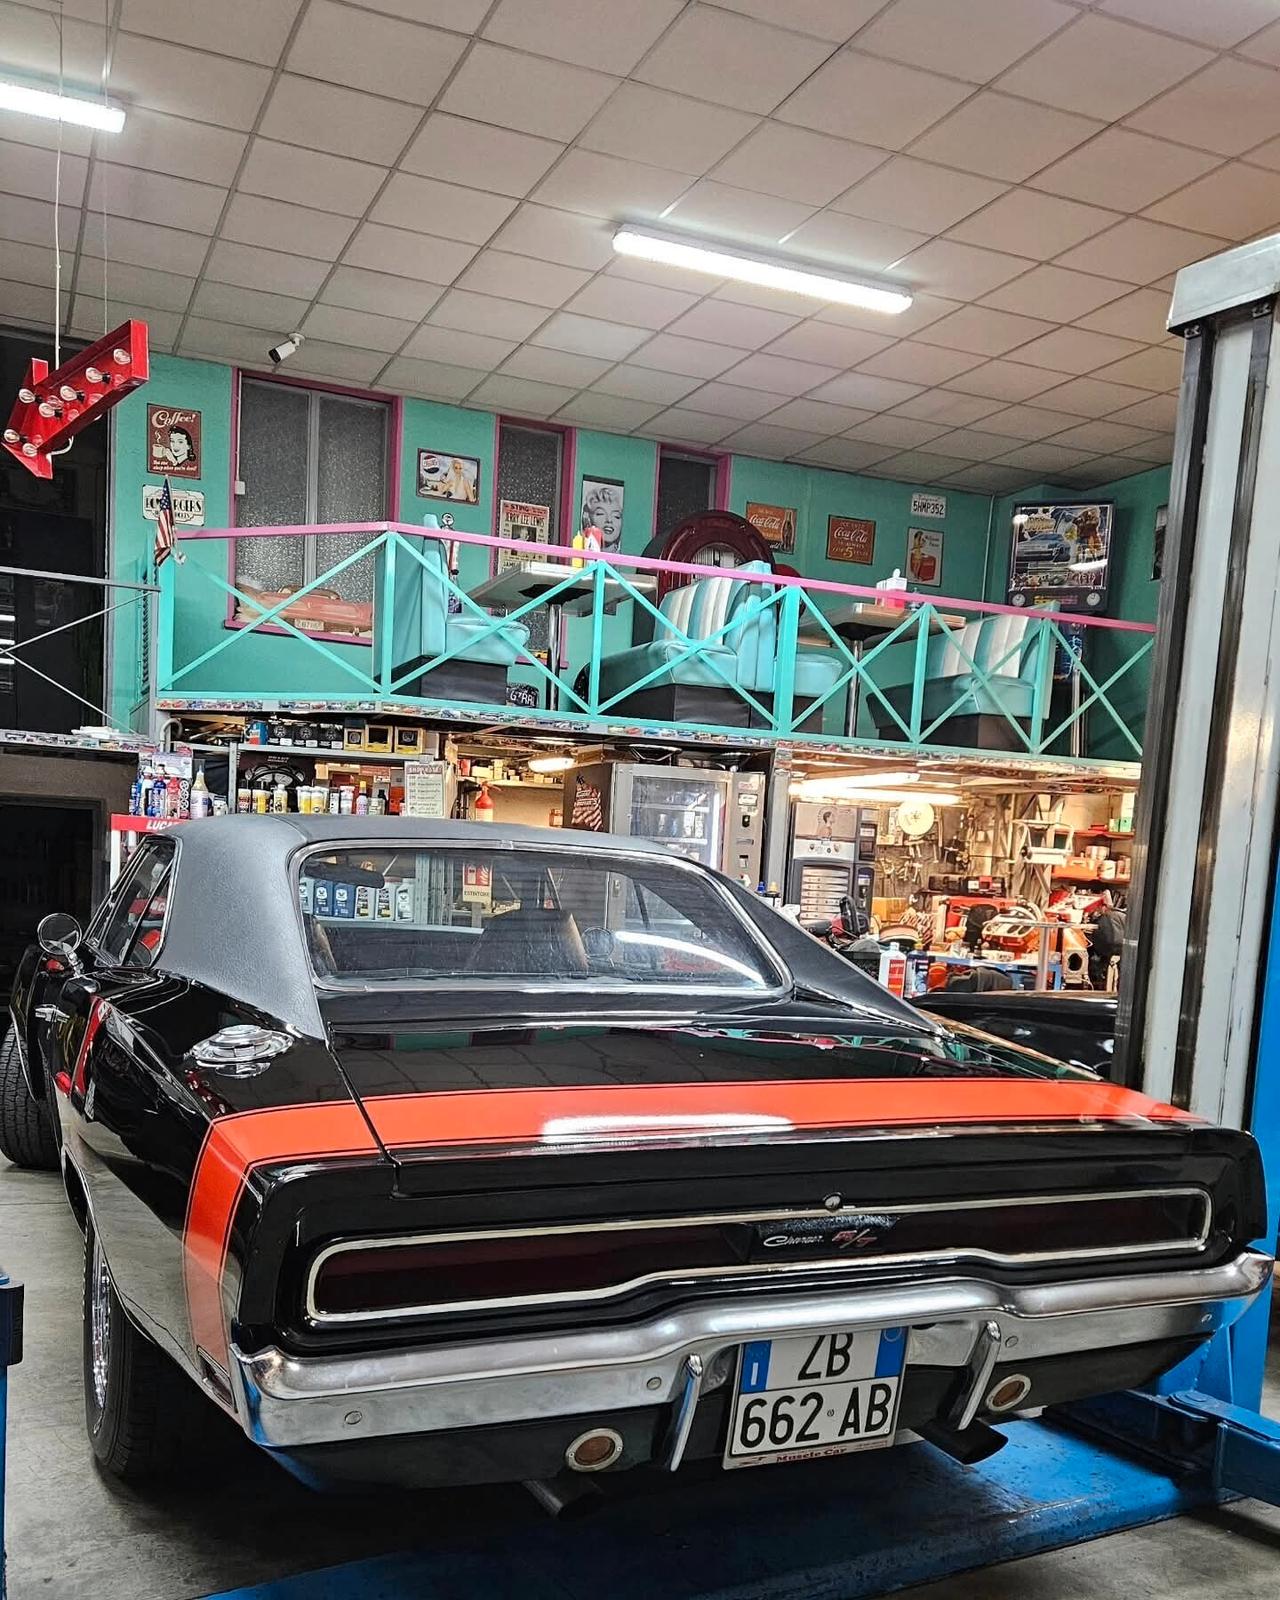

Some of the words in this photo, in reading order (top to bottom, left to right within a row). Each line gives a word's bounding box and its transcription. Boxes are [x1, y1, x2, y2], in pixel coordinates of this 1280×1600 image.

[152, 410, 196, 428] Coffee!
[913, 500, 944, 515] 5HMP352
[798, 1332, 853, 1381] ZB
[740, 1391, 824, 1449] 662
[838, 1383, 892, 1437] AB
[824, 1448, 847, 1456] Car
